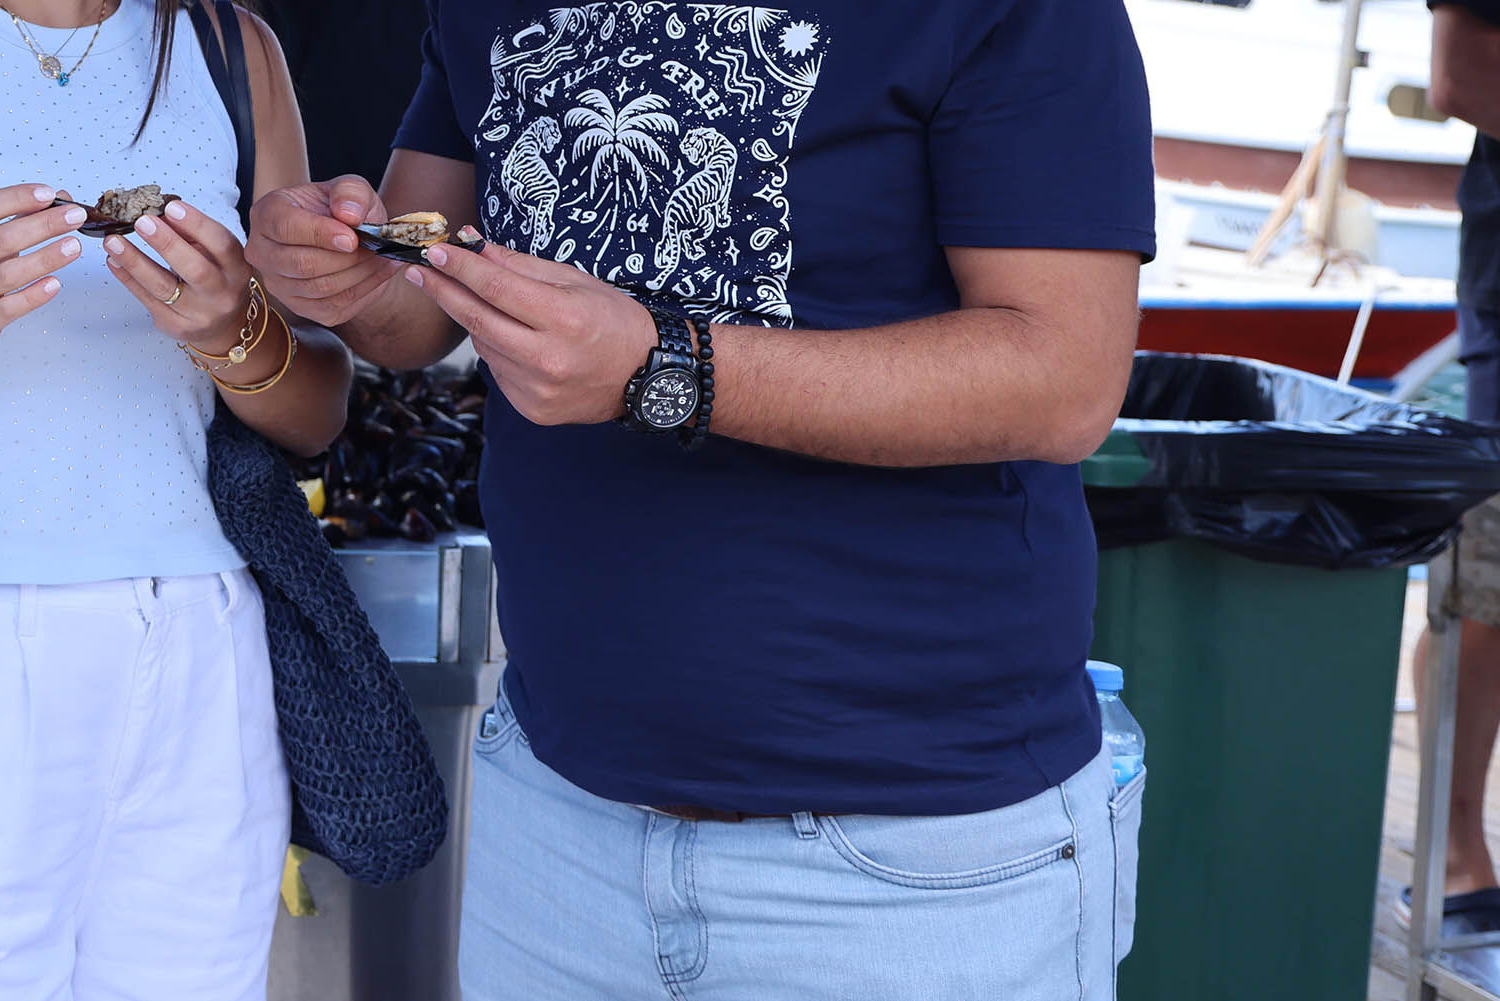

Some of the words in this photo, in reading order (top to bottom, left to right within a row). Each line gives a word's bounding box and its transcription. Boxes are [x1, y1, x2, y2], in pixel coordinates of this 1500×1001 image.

[534, 56, 610, 107] WILD
[618, 46, 654, 68] &
[661, 60, 728, 120] FREE
[568, 207, 598, 224] 19
[626, 213, 650, 233] 64
